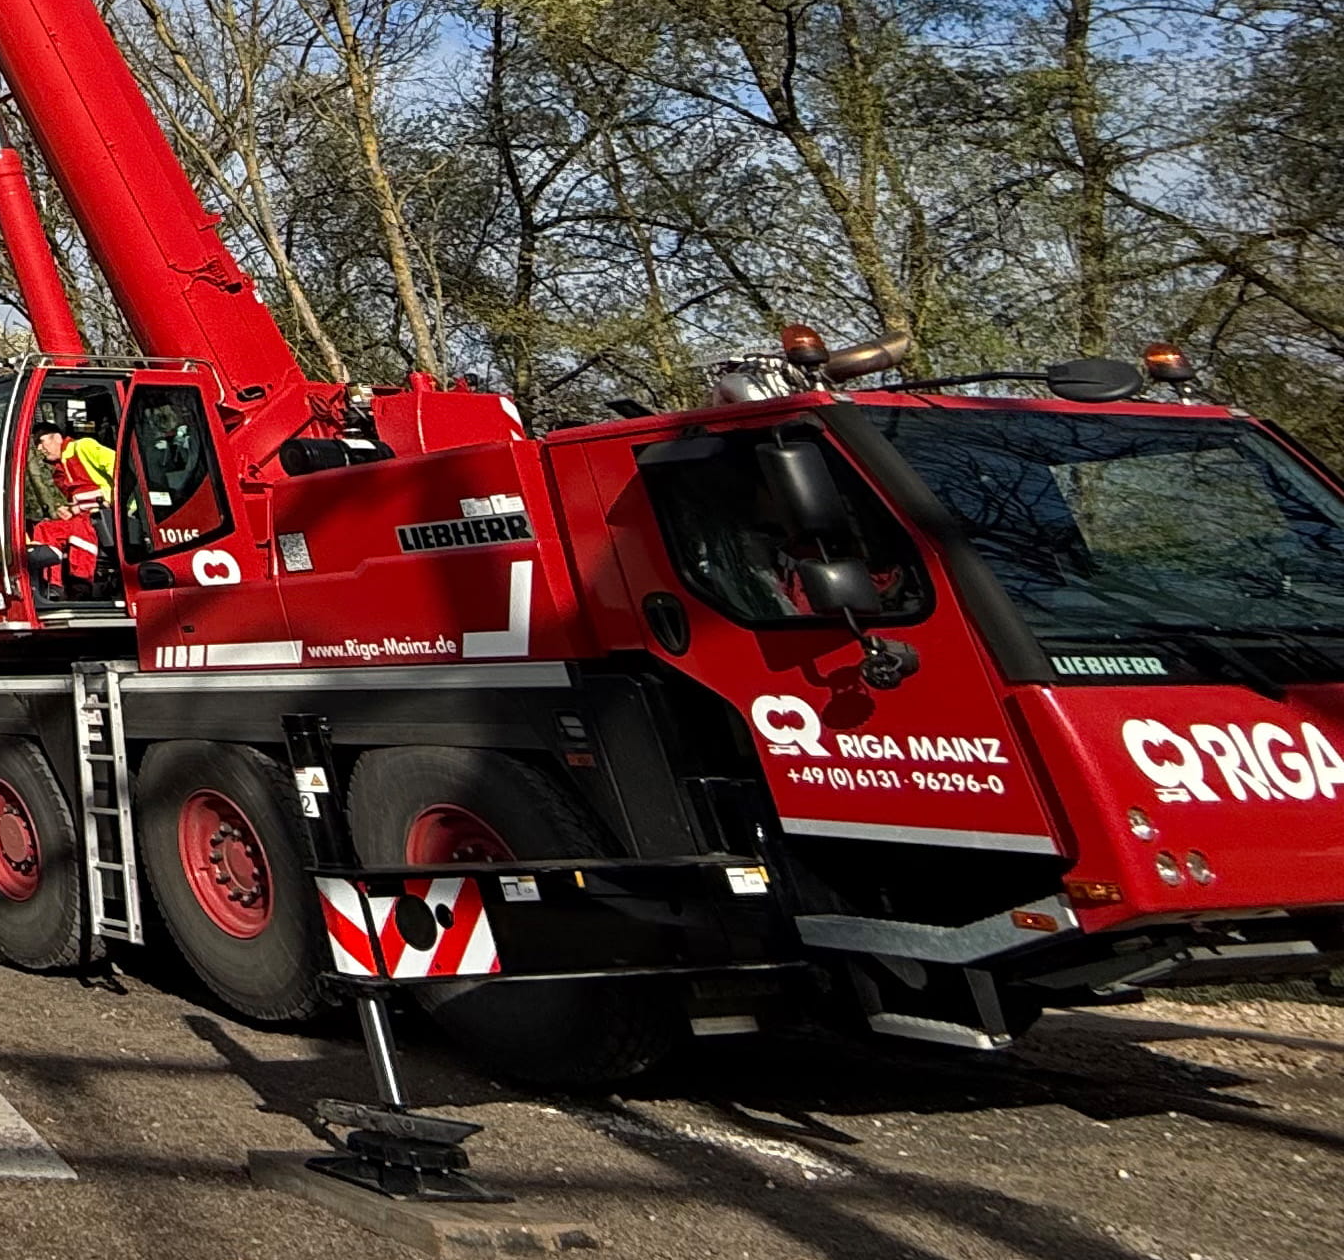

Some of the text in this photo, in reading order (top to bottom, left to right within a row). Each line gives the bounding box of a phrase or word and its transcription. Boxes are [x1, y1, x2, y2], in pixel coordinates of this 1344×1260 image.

[397, 514, 533, 551] LIEBHERR
[307, 634, 457, 661] www.Riga-Mainz.de
[1050, 656, 1169, 675] LIEBHERR
[835, 734, 905, 760] RIGA
[907, 735, 1009, 764] MAINZ
[1189, 721, 1344, 801] RIGA
[786, 767, 825, 785] +49
[827, 767, 856, 790] (0)
[856, 769, 901, 789] 6131
[911, 771, 1006, 795] 96296-0
[301, 794, 314, 814] 2
